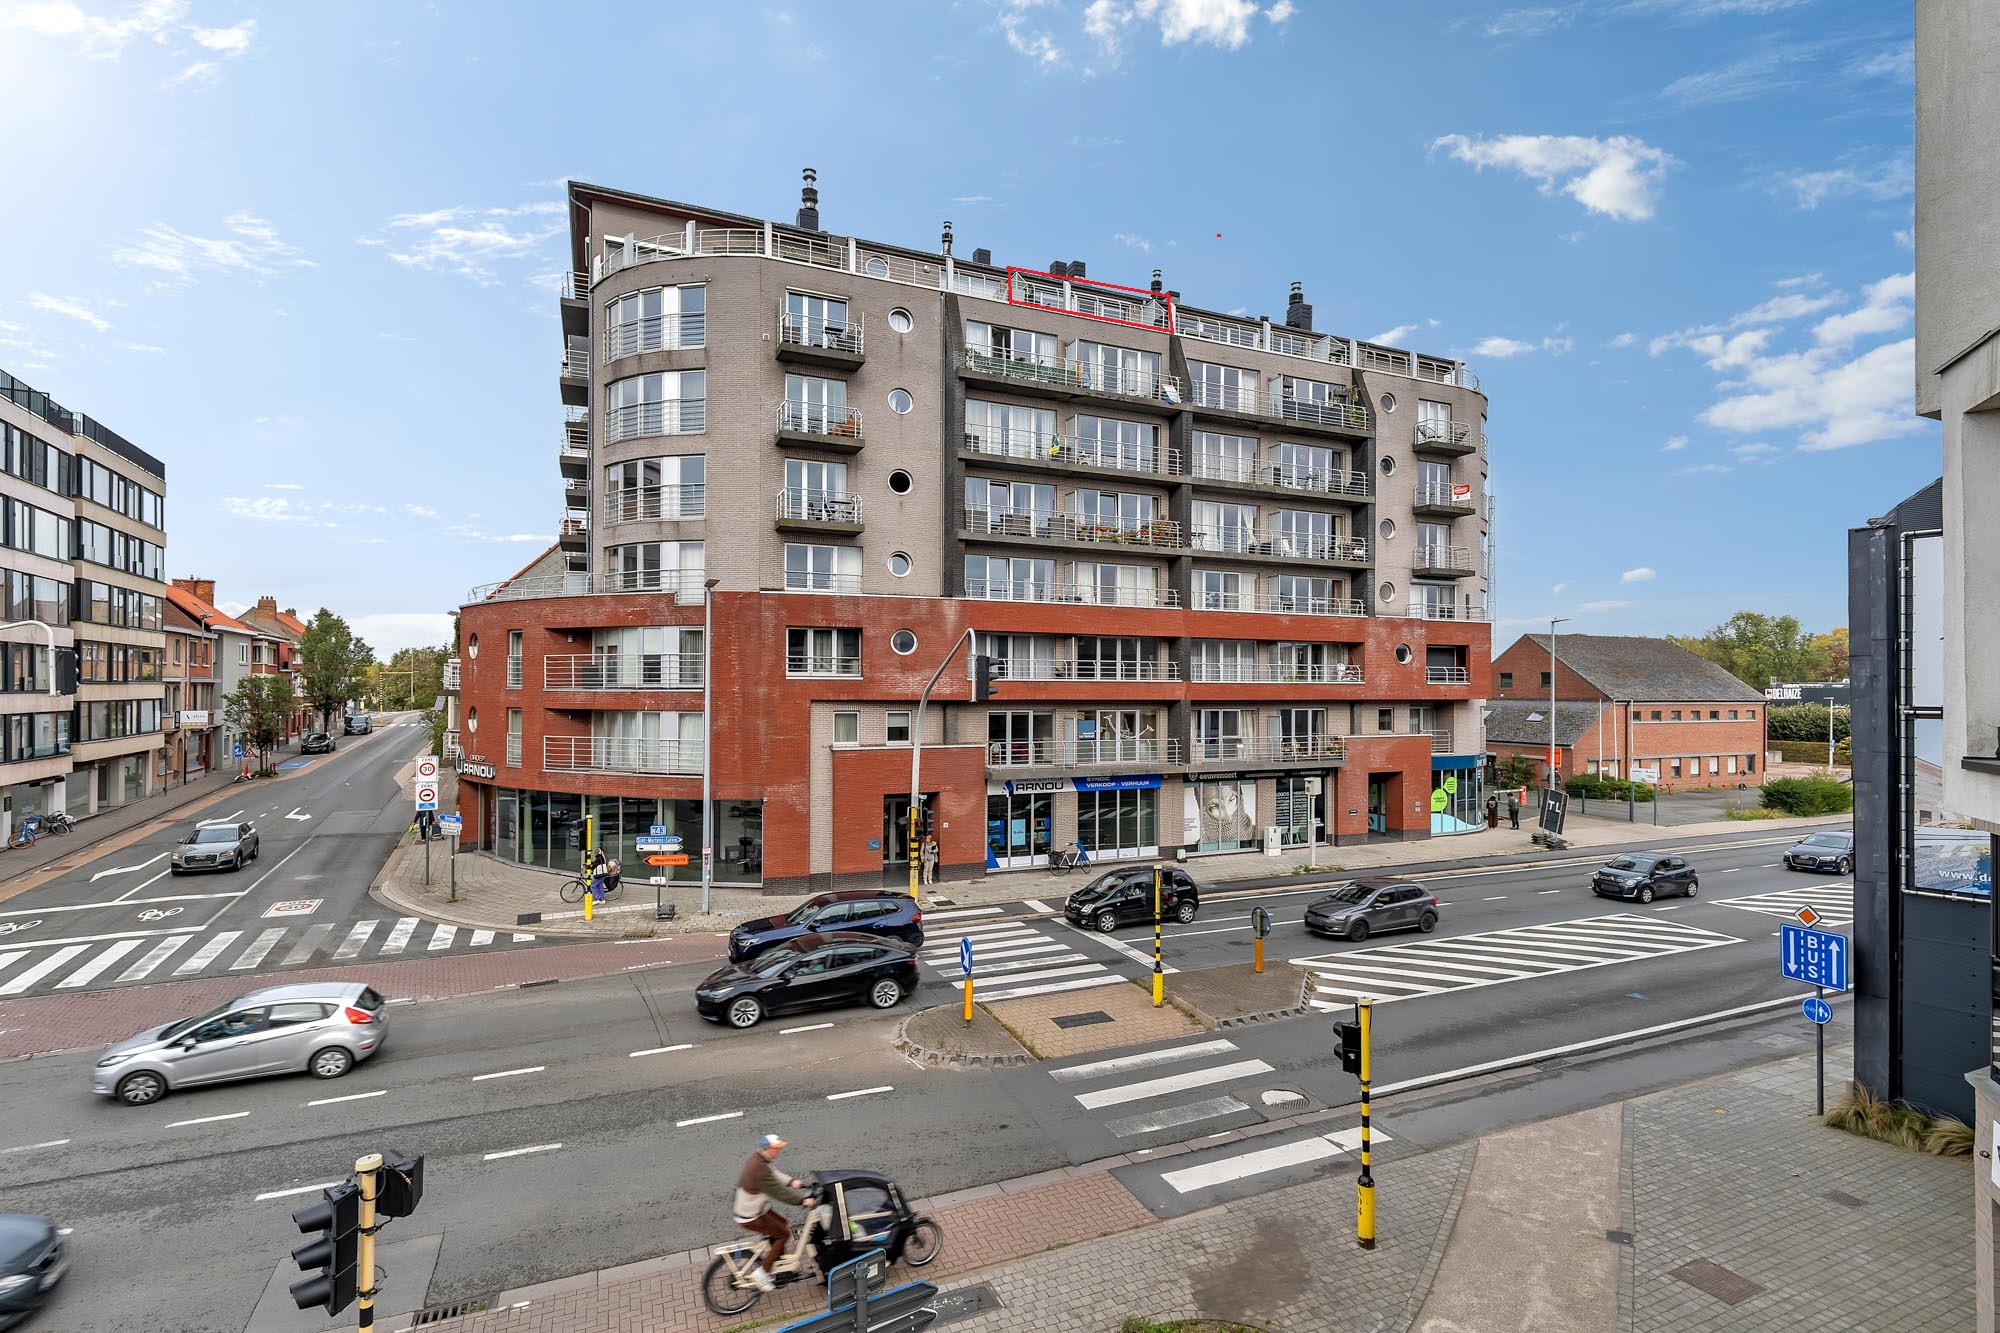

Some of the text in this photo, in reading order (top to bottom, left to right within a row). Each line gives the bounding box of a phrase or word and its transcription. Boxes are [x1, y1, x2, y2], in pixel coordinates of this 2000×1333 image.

[1772, 688, 1802, 700] DELHAIZE
[463, 763, 493, 779] ARNOU
[1015, 781, 1064, 792] ARNOU
[651, 826, 666, 834] N43
[1807, 935, 1819, 979] BUS
